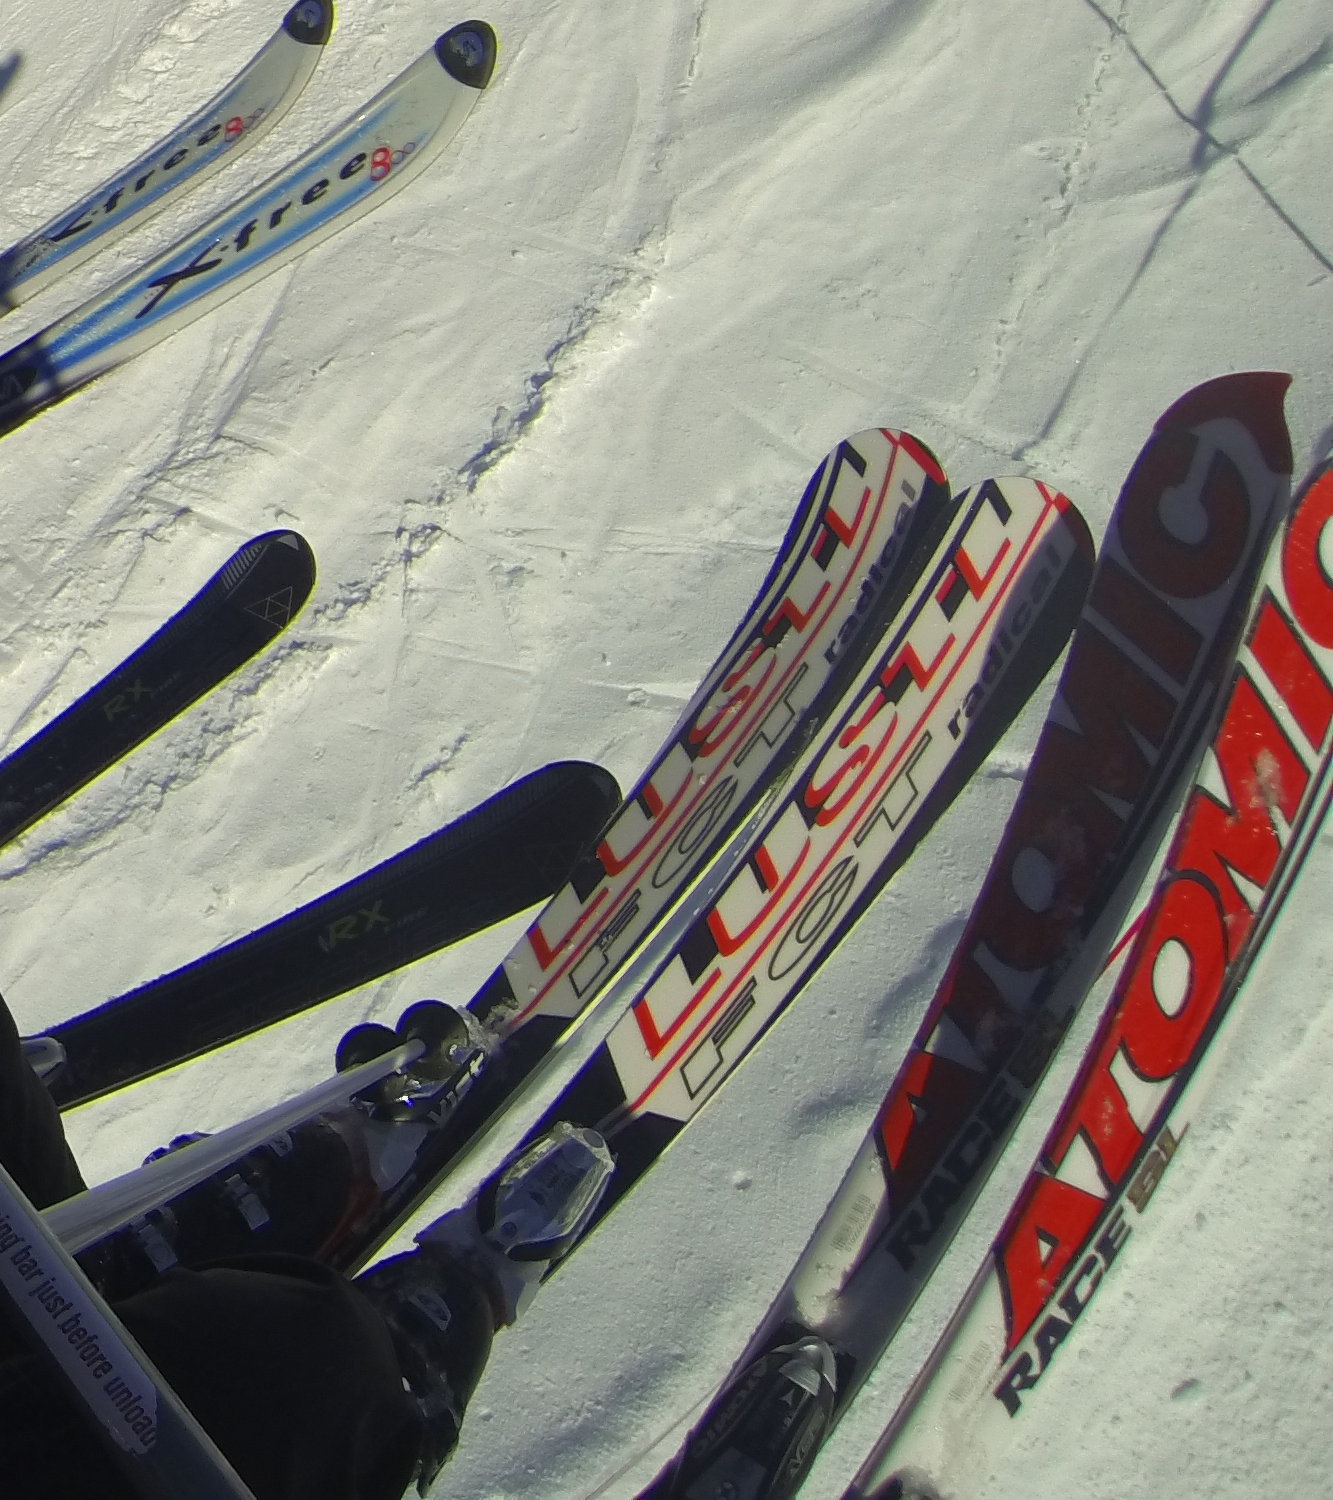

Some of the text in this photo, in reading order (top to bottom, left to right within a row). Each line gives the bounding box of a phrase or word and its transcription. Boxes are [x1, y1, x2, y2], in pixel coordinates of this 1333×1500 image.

[823, 481, 920, 664] radical
[947, 540, 1070, 739] radical
[99, 677, 153, 723] RX
[880, 418, 1255, 1215] ATOMIC
[326, 898, 390, 950] RX
[885, 1058, 1022, 1271] RACE
[13, 1244, 45, 1282] bar
[32, 1275, 75, 1322] just
[60, 1312, 115, 1380] before
[993, 1121, 1191, 1417] RACE SL
